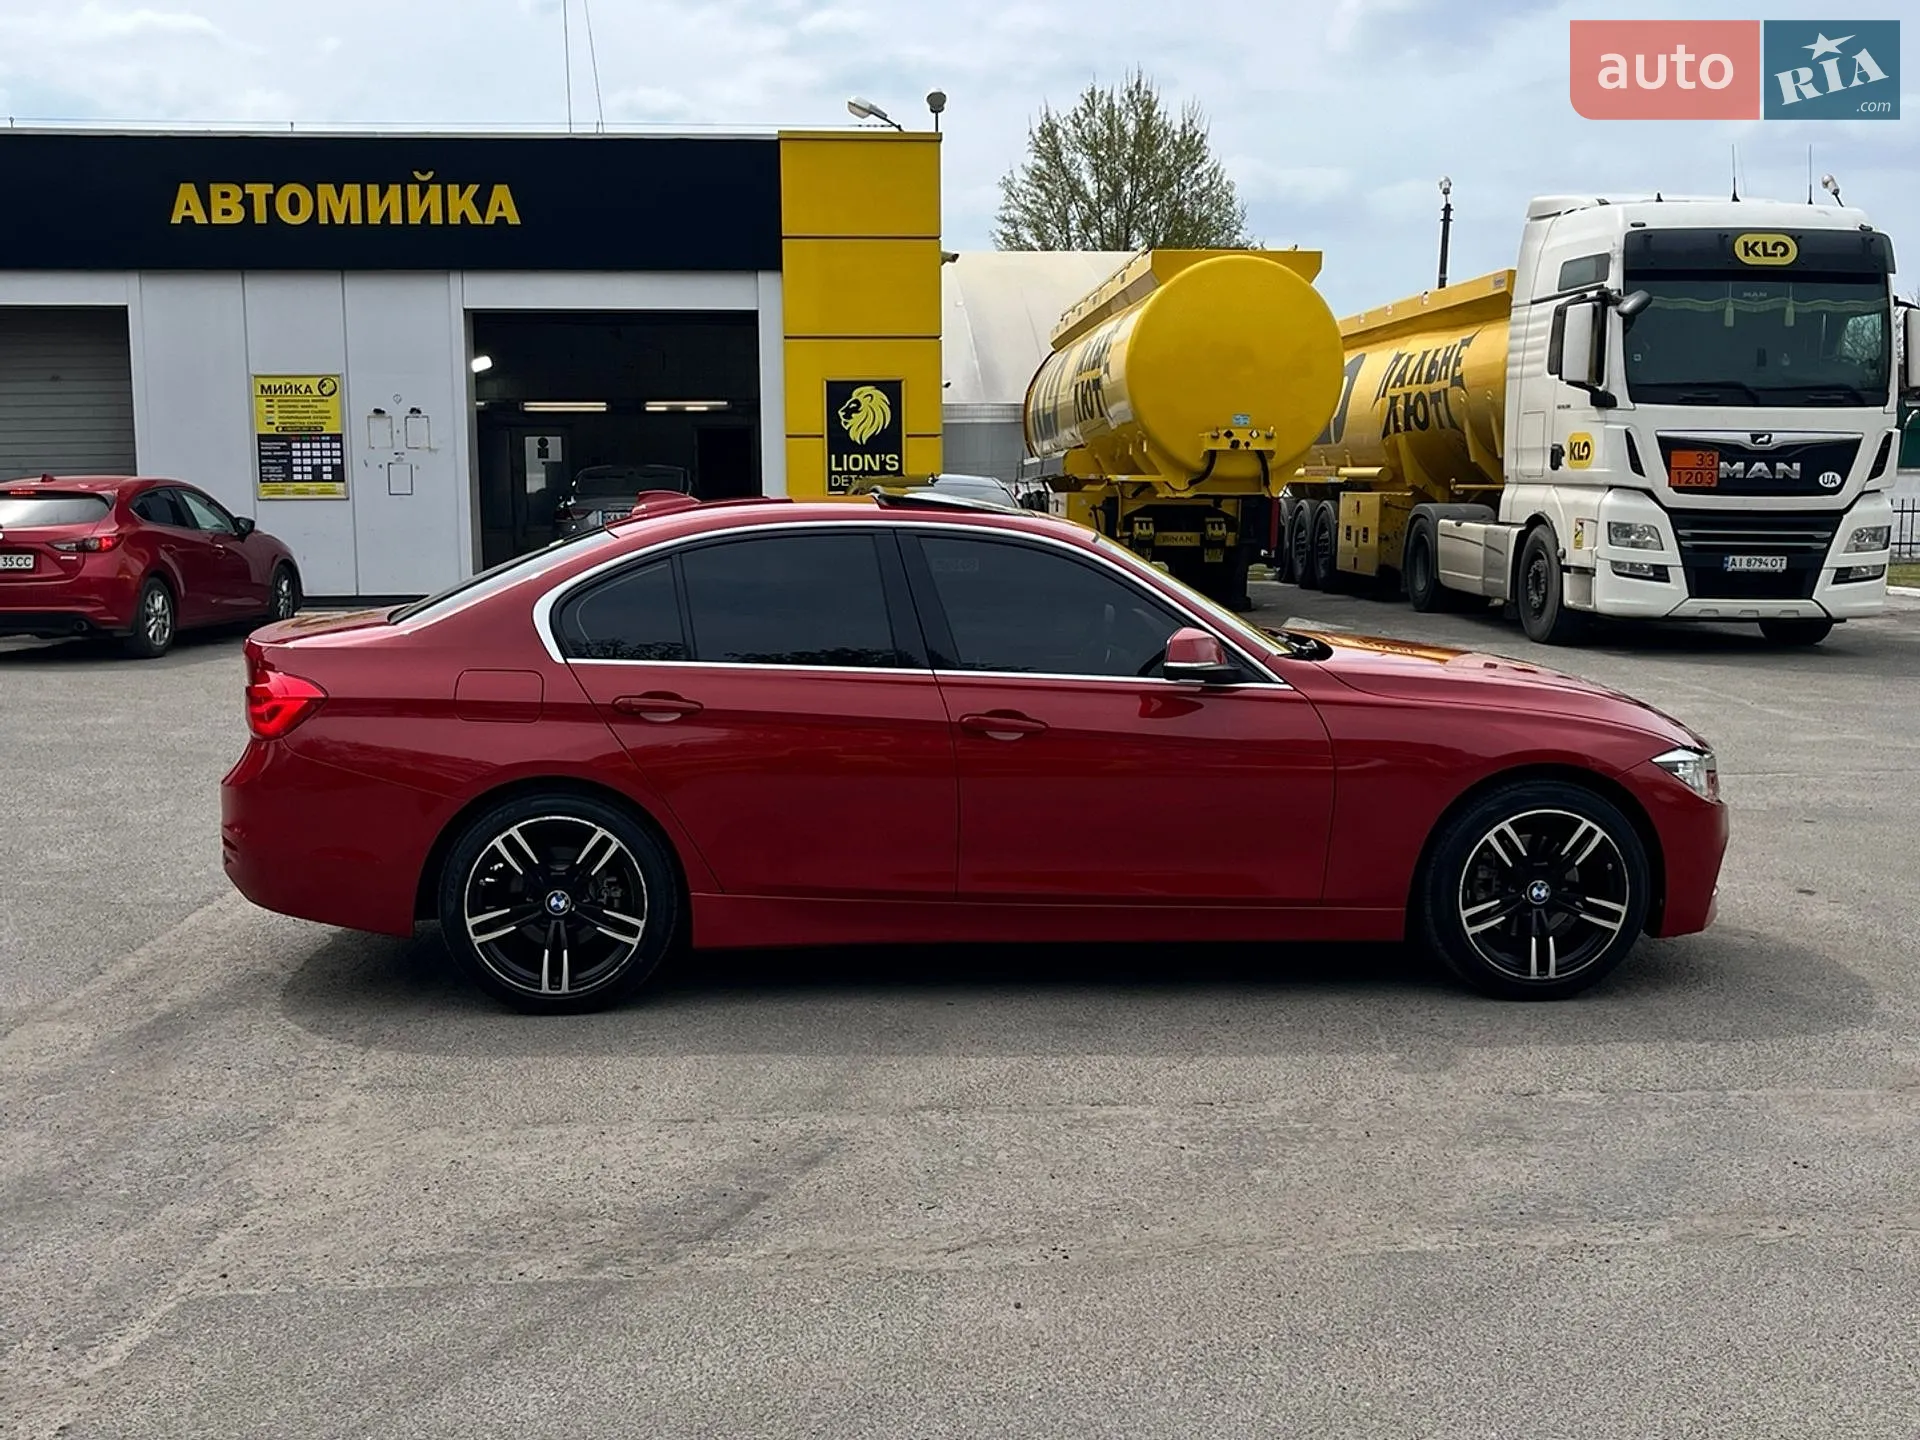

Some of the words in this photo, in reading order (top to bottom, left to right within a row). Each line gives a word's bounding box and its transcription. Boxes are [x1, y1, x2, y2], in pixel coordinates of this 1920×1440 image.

[170, 171, 521, 225] АВТОМИЙКА
[260, 381, 314, 395] МИЙКА
[830, 453, 900, 472] LION'S
[1695, 453, 1716, 467] 33
[1718, 461, 1801, 480] MAN
[1676, 471, 1715, 486] 1203
[1821, 475, 1838, 486] UA
